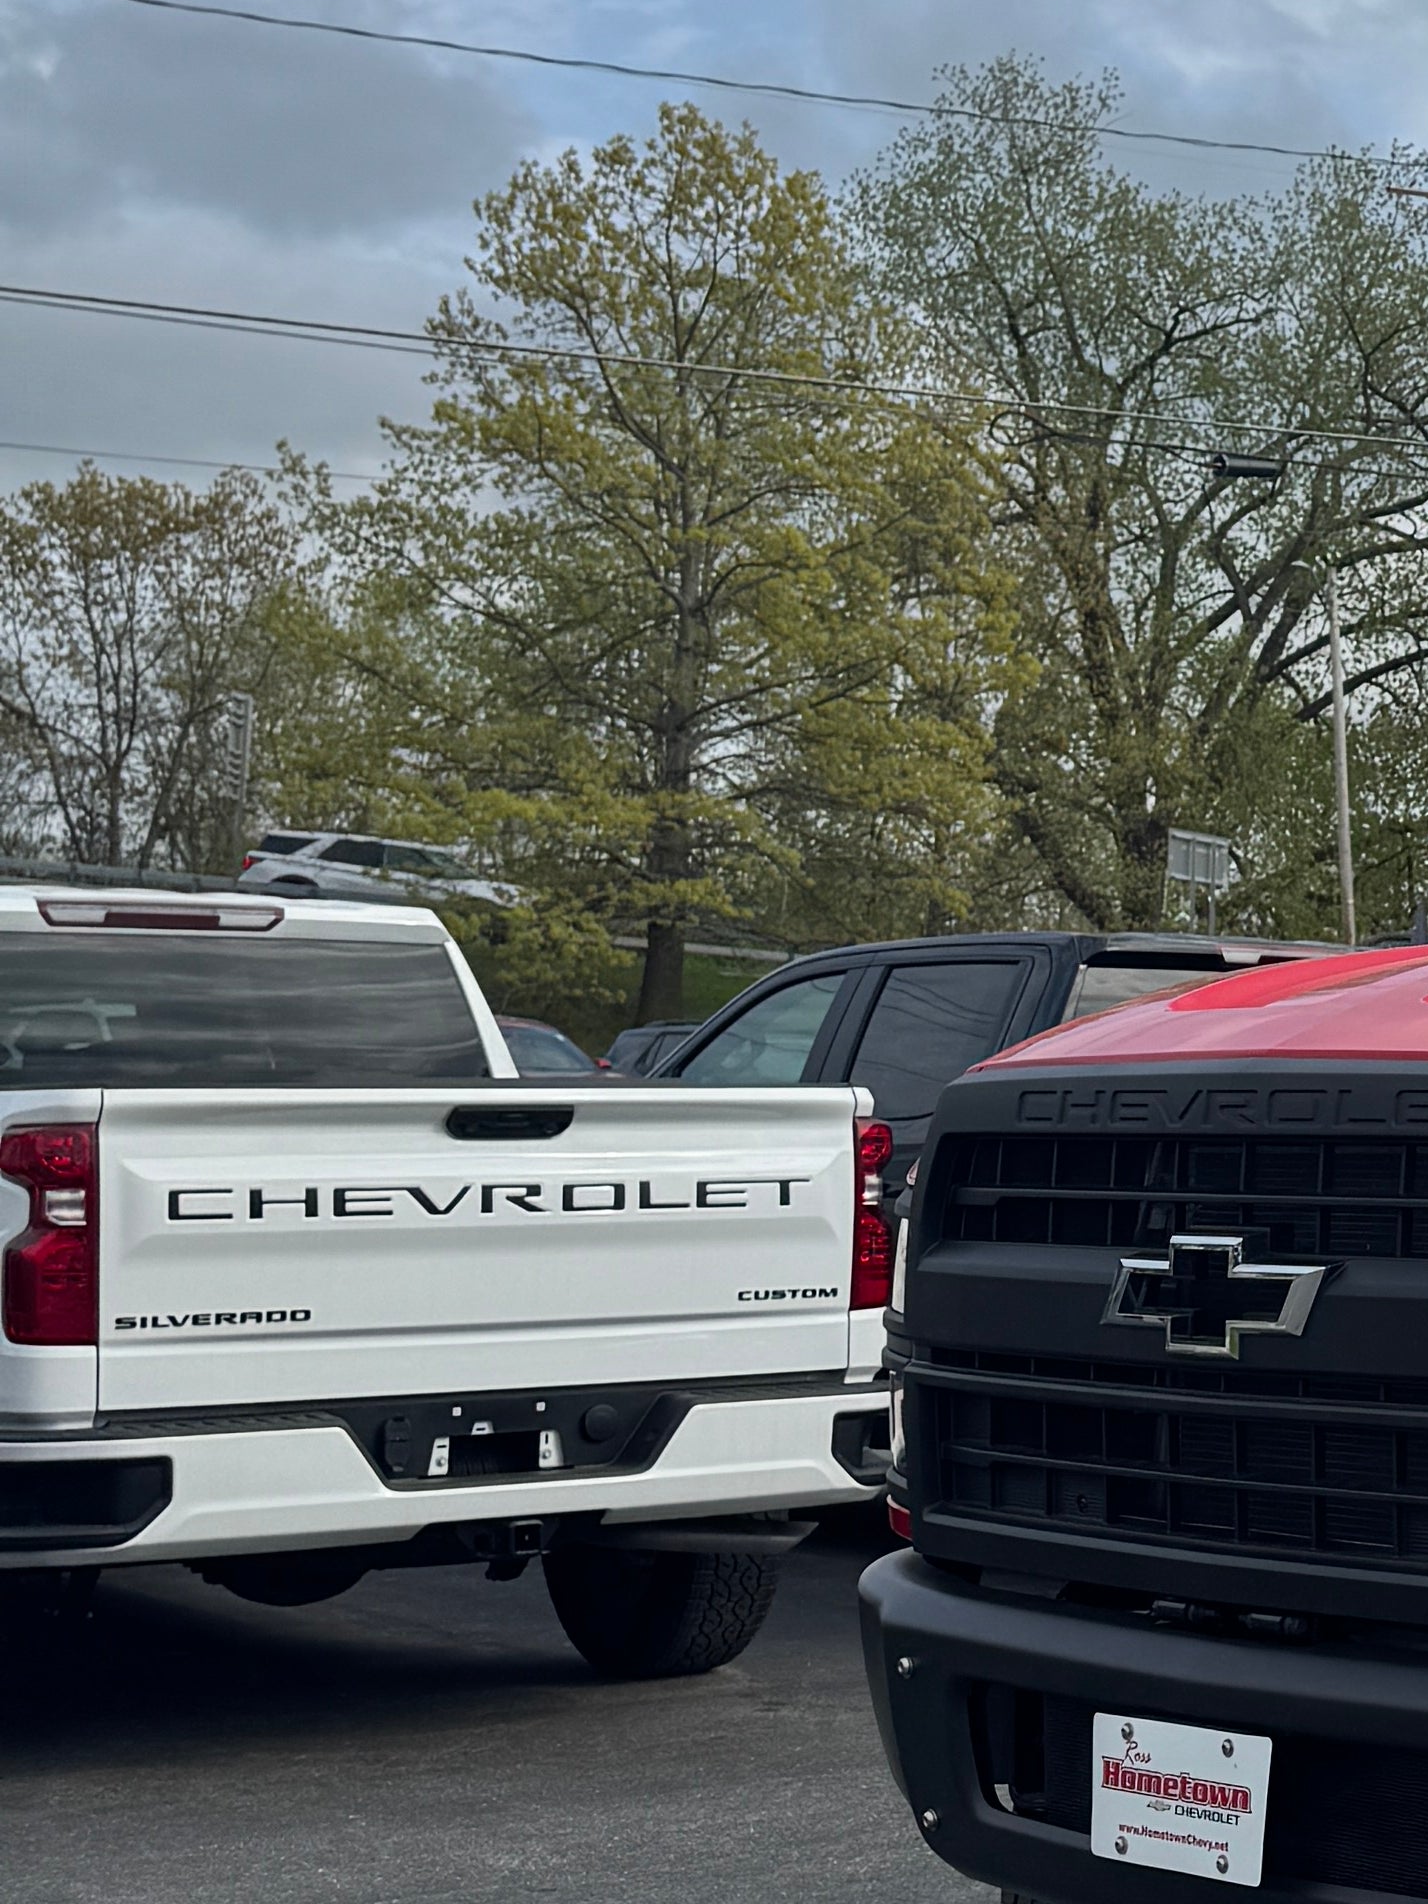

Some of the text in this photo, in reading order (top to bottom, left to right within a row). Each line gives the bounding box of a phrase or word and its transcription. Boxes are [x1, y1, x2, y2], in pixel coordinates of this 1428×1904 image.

[167, 1178, 811, 1222] CHEVROLET
[737, 1286, 839, 1302] CUSTOM
[114, 1309, 312, 1331] SILVERADO
[1121, 1738, 1152, 1765] Ross
[1101, 1756, 1253, 1814] Hometown
[1174, 1804, 1241, 1826] CHEVROLET
[1118, 1822, 1229, 1852] www.HometownChevy.net
